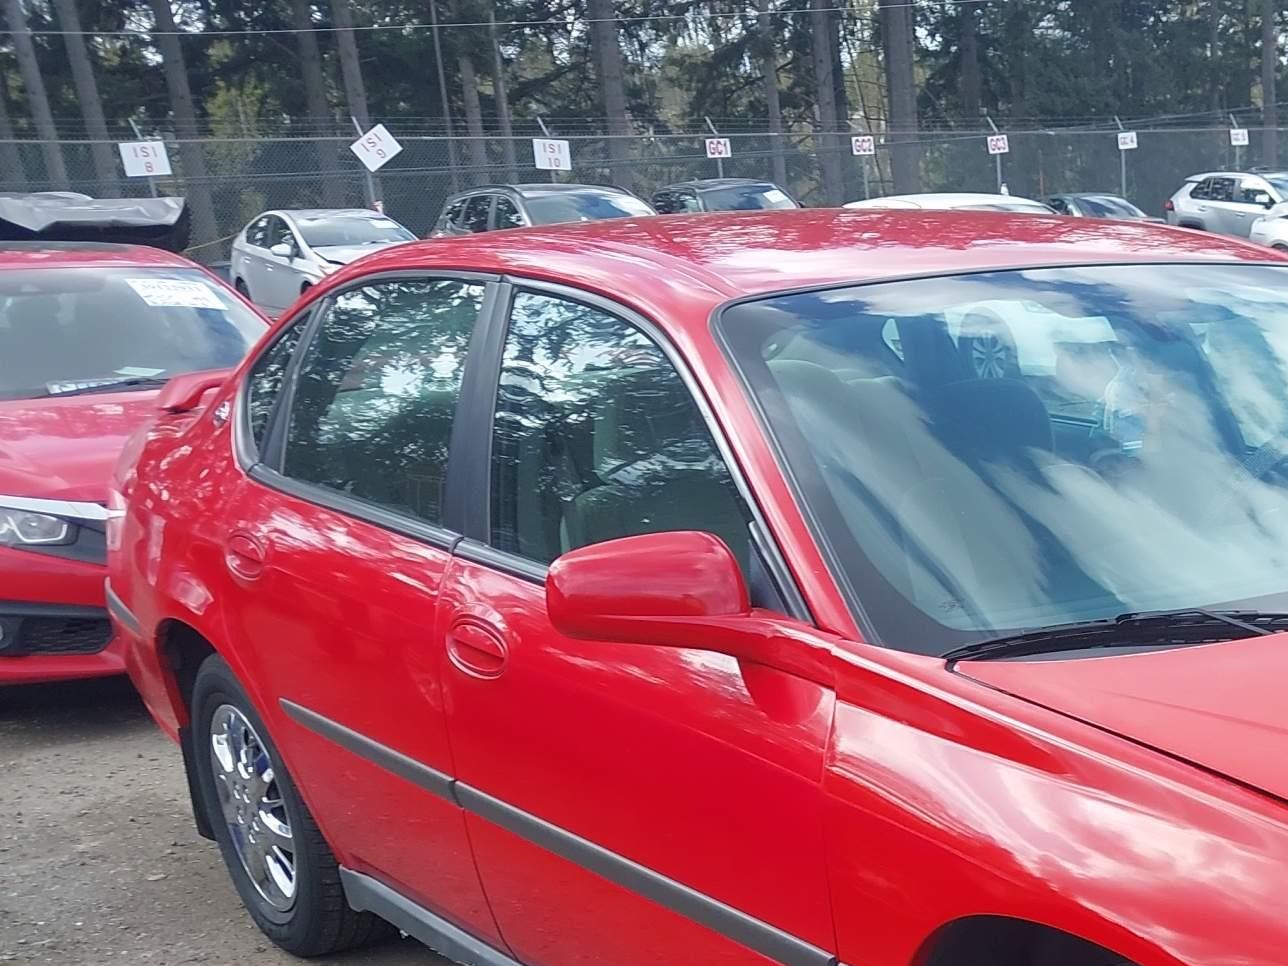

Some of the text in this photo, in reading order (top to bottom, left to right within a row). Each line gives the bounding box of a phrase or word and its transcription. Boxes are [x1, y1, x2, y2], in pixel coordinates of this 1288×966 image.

[709, 140, 729, 156] GC1
[855, 138, 873, 153] GC2
[990, 136, 1007, 152] GC3
[144, 161, 154, 173] 8
